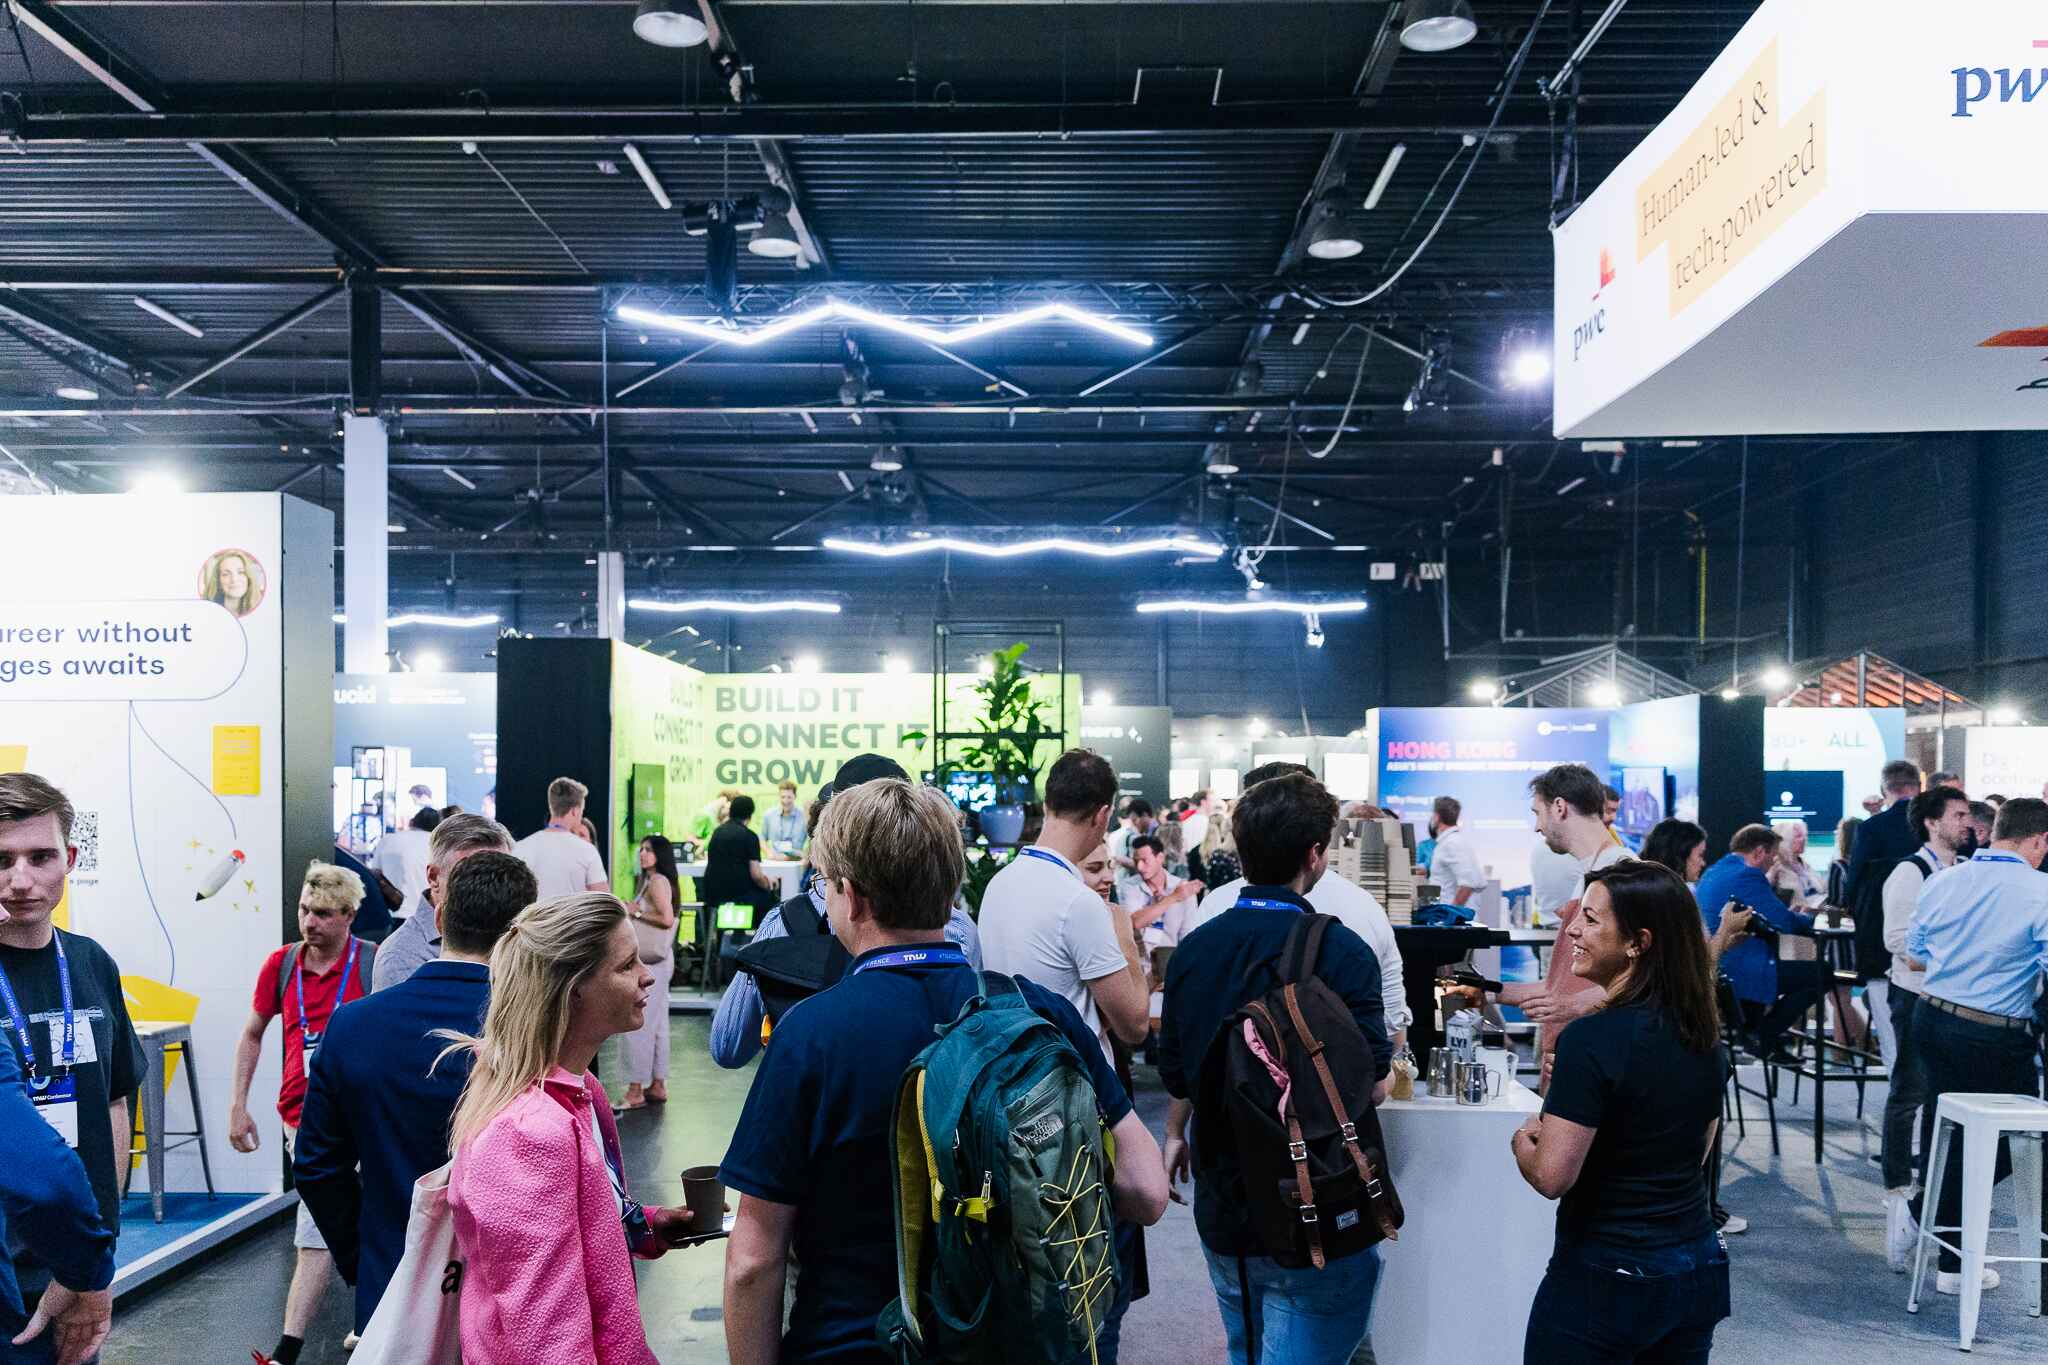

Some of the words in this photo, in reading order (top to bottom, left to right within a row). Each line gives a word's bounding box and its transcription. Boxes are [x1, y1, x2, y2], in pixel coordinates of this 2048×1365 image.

[1641, 96, 1744, 237] Human-led
[1752, 80, 1768, 126] &
[1675, 121, 1815, 289] tech-powered
[1573, 308, 1606, 362] pwc
[0, 627, 64, 643] reer
[77, 621, 193, 643] without
[0, 659, 52, 683] ges
[62, 653, 165, 675] awaits
[715, 687, 822, 713] BUILD
[832, 687, 865, 713] IT
[714, 722, 886, 749] CONNECT
[1387, 741, 1451, 759] HONG
[715, 758, 826, 785] GROW
[903, 952, 927, 962] TNW
